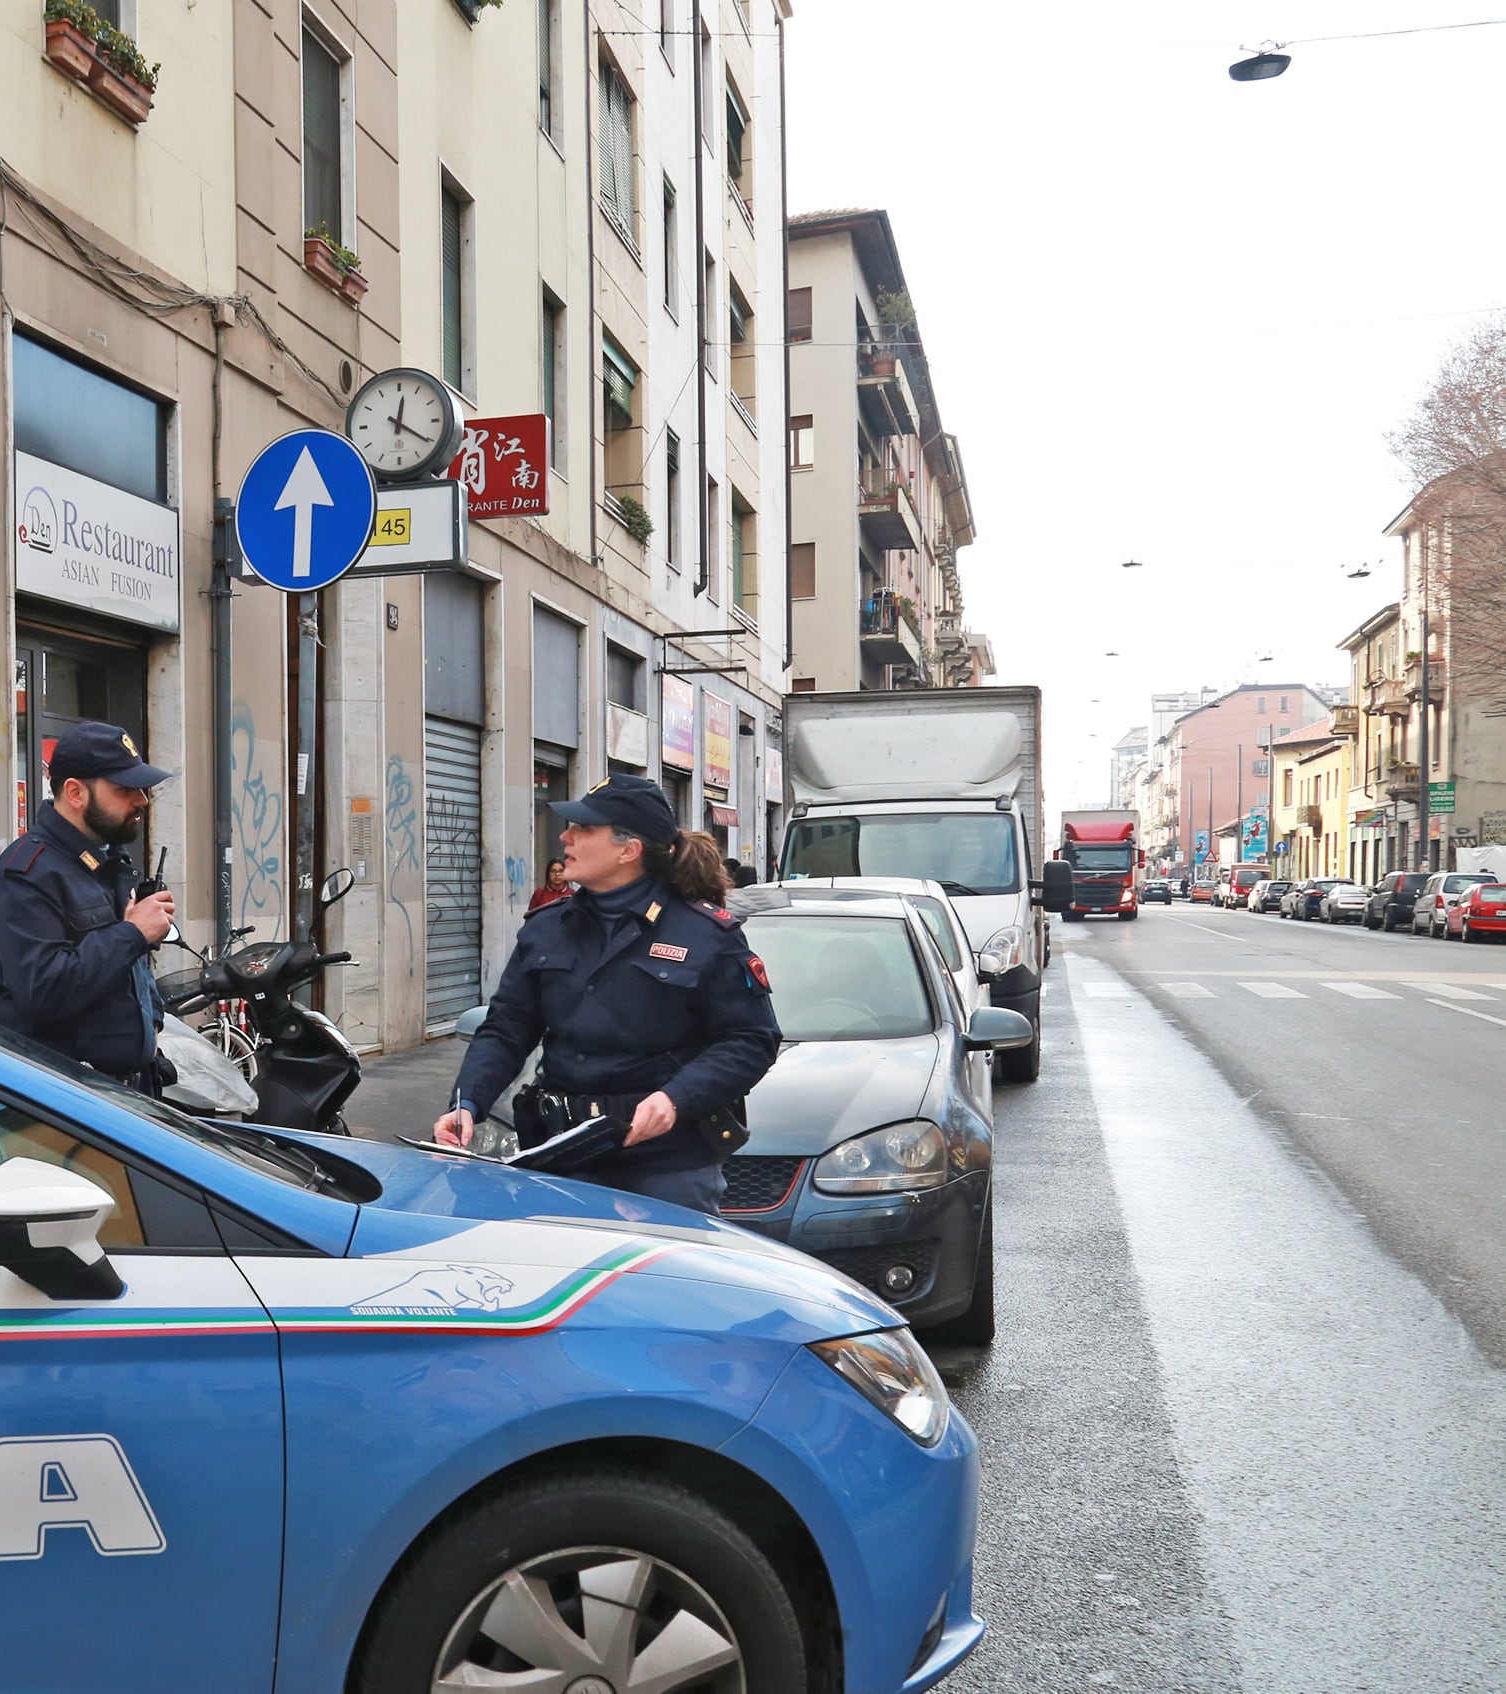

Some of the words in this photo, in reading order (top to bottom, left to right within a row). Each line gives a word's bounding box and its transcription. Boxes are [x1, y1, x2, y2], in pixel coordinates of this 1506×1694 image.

[467, 500, 508, 512] RANTE
[511, 496, 540, 509] Den
[27, 504, 52, 544] Den
[61, 498, 175, 579] Restaurant
[61, 558, 100, 586] ASIAN
[111, 572, 152, 601] FUSION
[652, 945, 684, 959] POLIZIA
[349, 1306, 405, 1316] SQUADRA
[406, 1306, 458, 1317] VOLANTE
